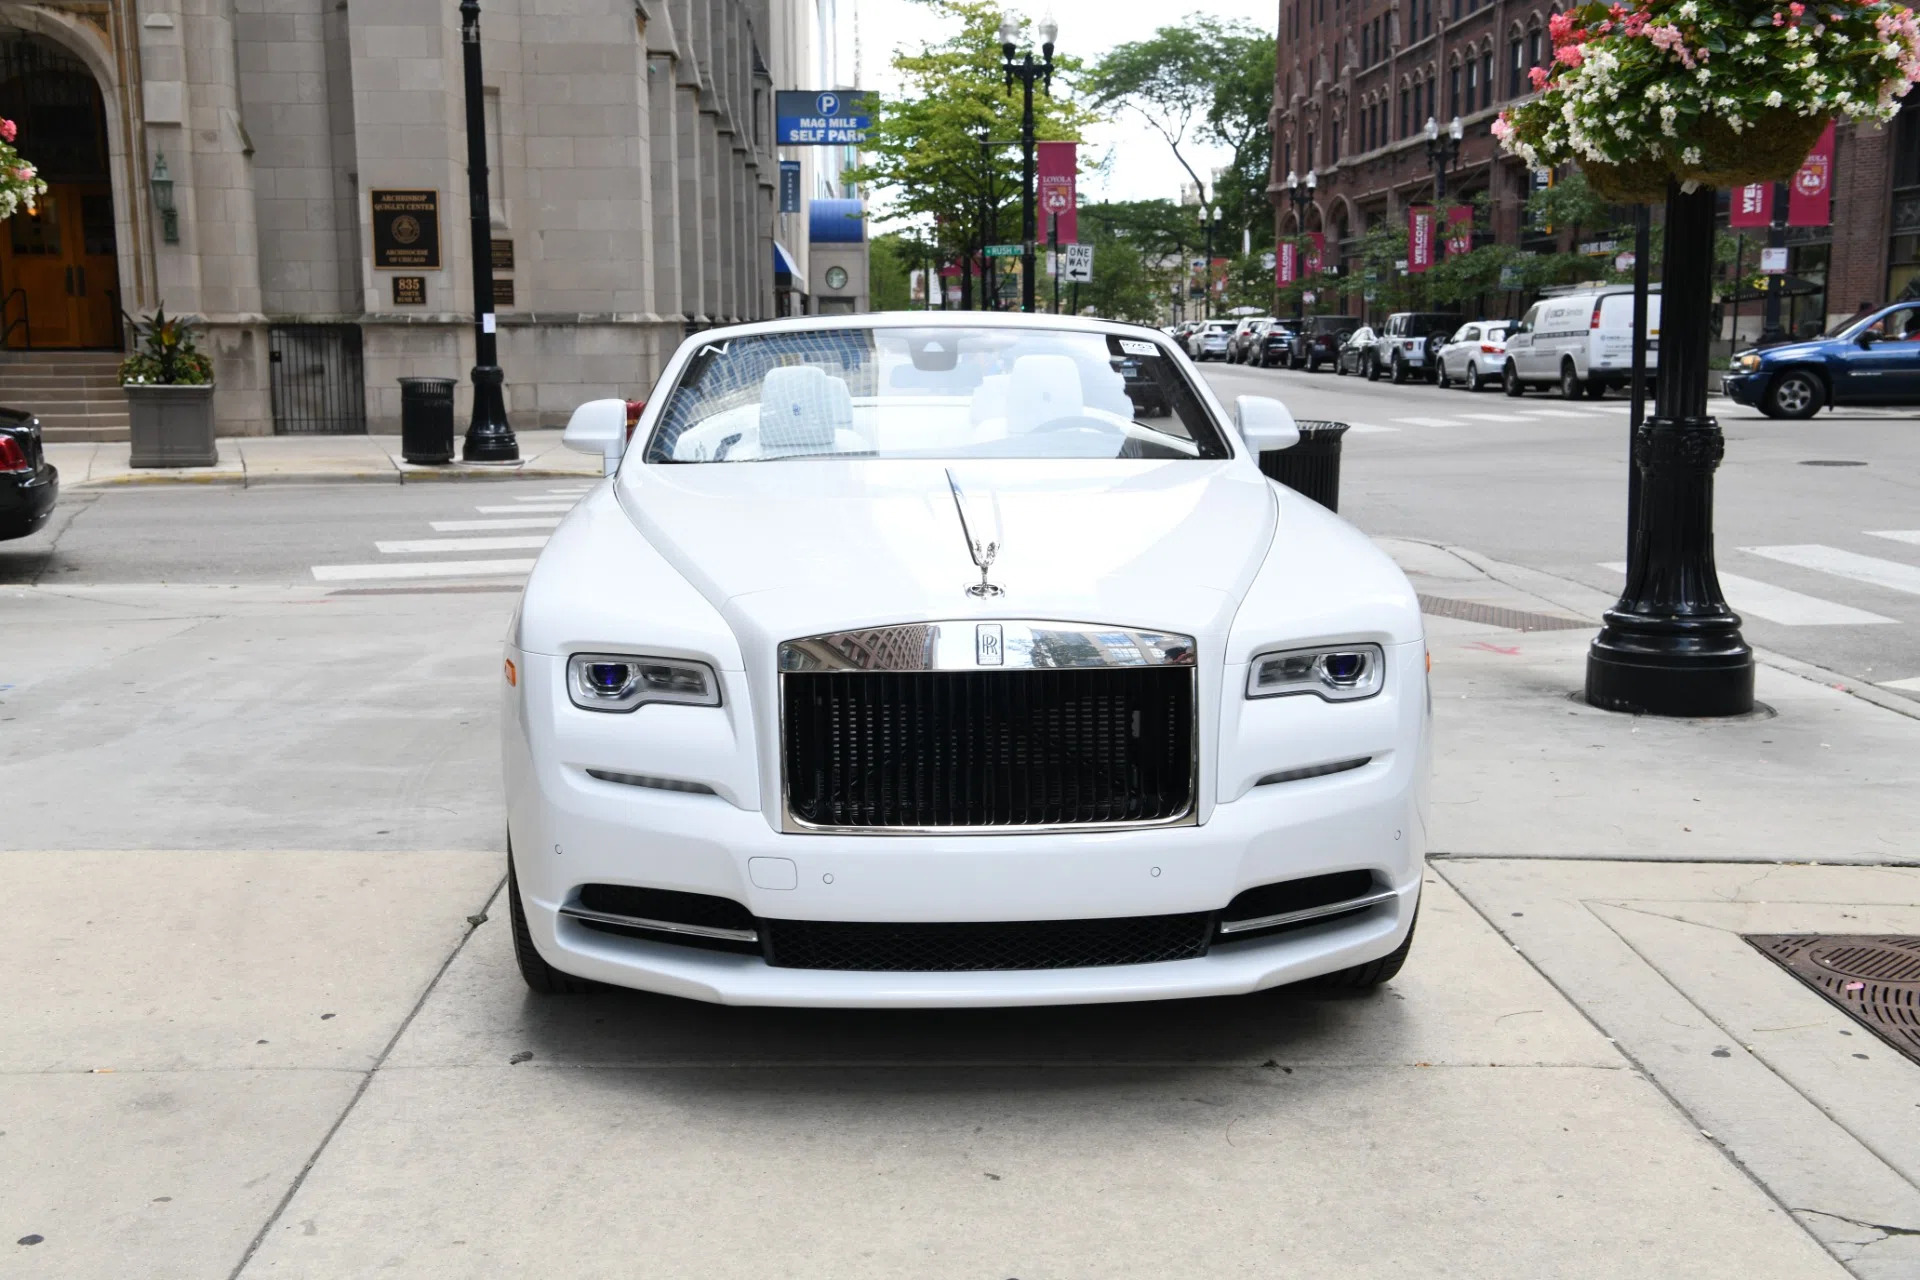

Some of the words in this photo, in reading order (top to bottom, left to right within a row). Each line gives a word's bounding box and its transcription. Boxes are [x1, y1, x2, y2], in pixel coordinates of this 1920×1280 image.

[800, 118, 826, 128] MAG
[829, 118, 857, 128] MILE
[790, 129, 825, 141] SELF
[1042, 175, 1071, 183] LOYOLA
[382, 194, 427, 202] ARCHBISHOP
[374, 203, 405, 211] QUIGLEY
[1415, 215, 1424, 264] WELCOME
[991, 246, 1011, 256] RUSH
[1069, 247, 1089, 257] ONE
[1069, 259, 1090, 268] WAY
[398, 278, 419, 289] 835
